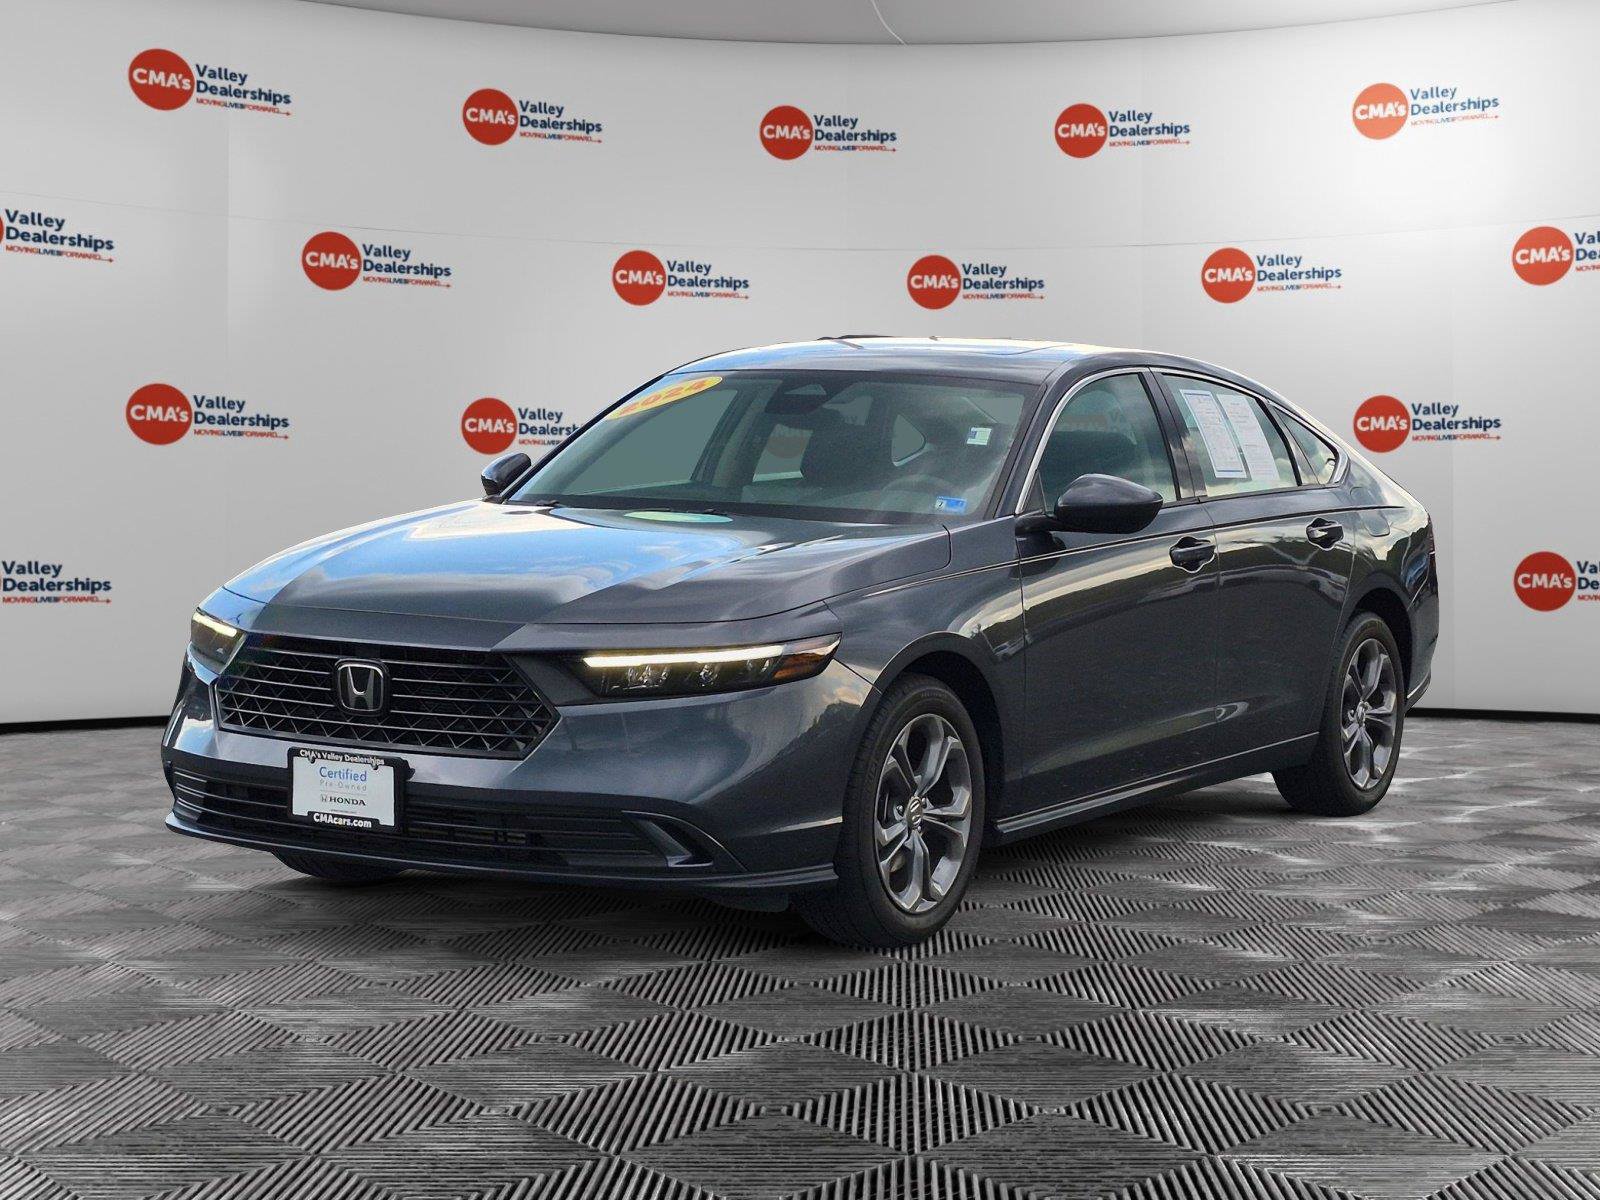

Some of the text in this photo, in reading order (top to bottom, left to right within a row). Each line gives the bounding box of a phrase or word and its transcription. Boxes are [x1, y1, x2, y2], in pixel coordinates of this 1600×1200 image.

[133, 68, 191, 90] CMA's
[195, 64, 248, 86] Valley
[196, 80, 291, 105] Dealerships
[1410, 86, 1457, 100] Valley
[519, 100, 564, 118] Valley
[1355, 102, 1406, 120] CMA's
[1411, 98, 1499, 116] Dealerships
[466, 108, 515, 125] CMA's
[813, 115, 858, 130] Valley
[1108, 110, 1153, 123] Valley
[520, 115, 602, 135] Dealerships
[763, 125, 811, 139] CMA's
[1058, 123, 1105, 138] CMA's
[1109, 123, 1190, 137] Dealerships
[815, 129, 897, 143] Dealerships
[5, 209, 65, 232] Valley
[6, 226, 114, 252] Dealerships
[305, 252, 358, 269] CMA's
[362, 244, 411, 262] Valley
[1515, 246, 1570, 264] CMA's
[1575, 248, 1600, 261] De
[363, 259, 452, 278] Dealerships
[667, 260, 712, 276] Valley
[1256, 254, 1302, 269] Valley
[615, 270, 663, 285] CMA's
[962, 263, 1007, 277] Valley
[1205, 267, 1253, 283] CMA's
[1257, 267, 1342, 282] Dealerships
[668, 275, 749, 291] Dealerships
[910, 275, 958, 289] CMA's
[963, 277, 1045, 291] Dealerships
[193, 395, 246, 413] Valley
[618, 379, 706, 415] 2024
[130, 404, 189, 422] CMA's
[518, 407, 563, 424] Valley
[1411, 402, 1459, 417] Valley
[194, 411, 290, 430] Dealerships
[465, 418, 514, 433] CMA's
[1357, 416, 1407, 431] CMA's
[1412, 416, 1502, 431] Dealerships
[1, 561, 63, 578] Valley
[2, 577, 112, 594] Dealerships
[1518, 573, 1572, 588] CMA's
[322, 752, 343, 762] Valley
[344, 754, 385, 765] Dealerships
[319, 766, 367, 781] Certified
[330, 796, 366, 806] HONDA
[313, 813, 371, 828] CMAcars.com
